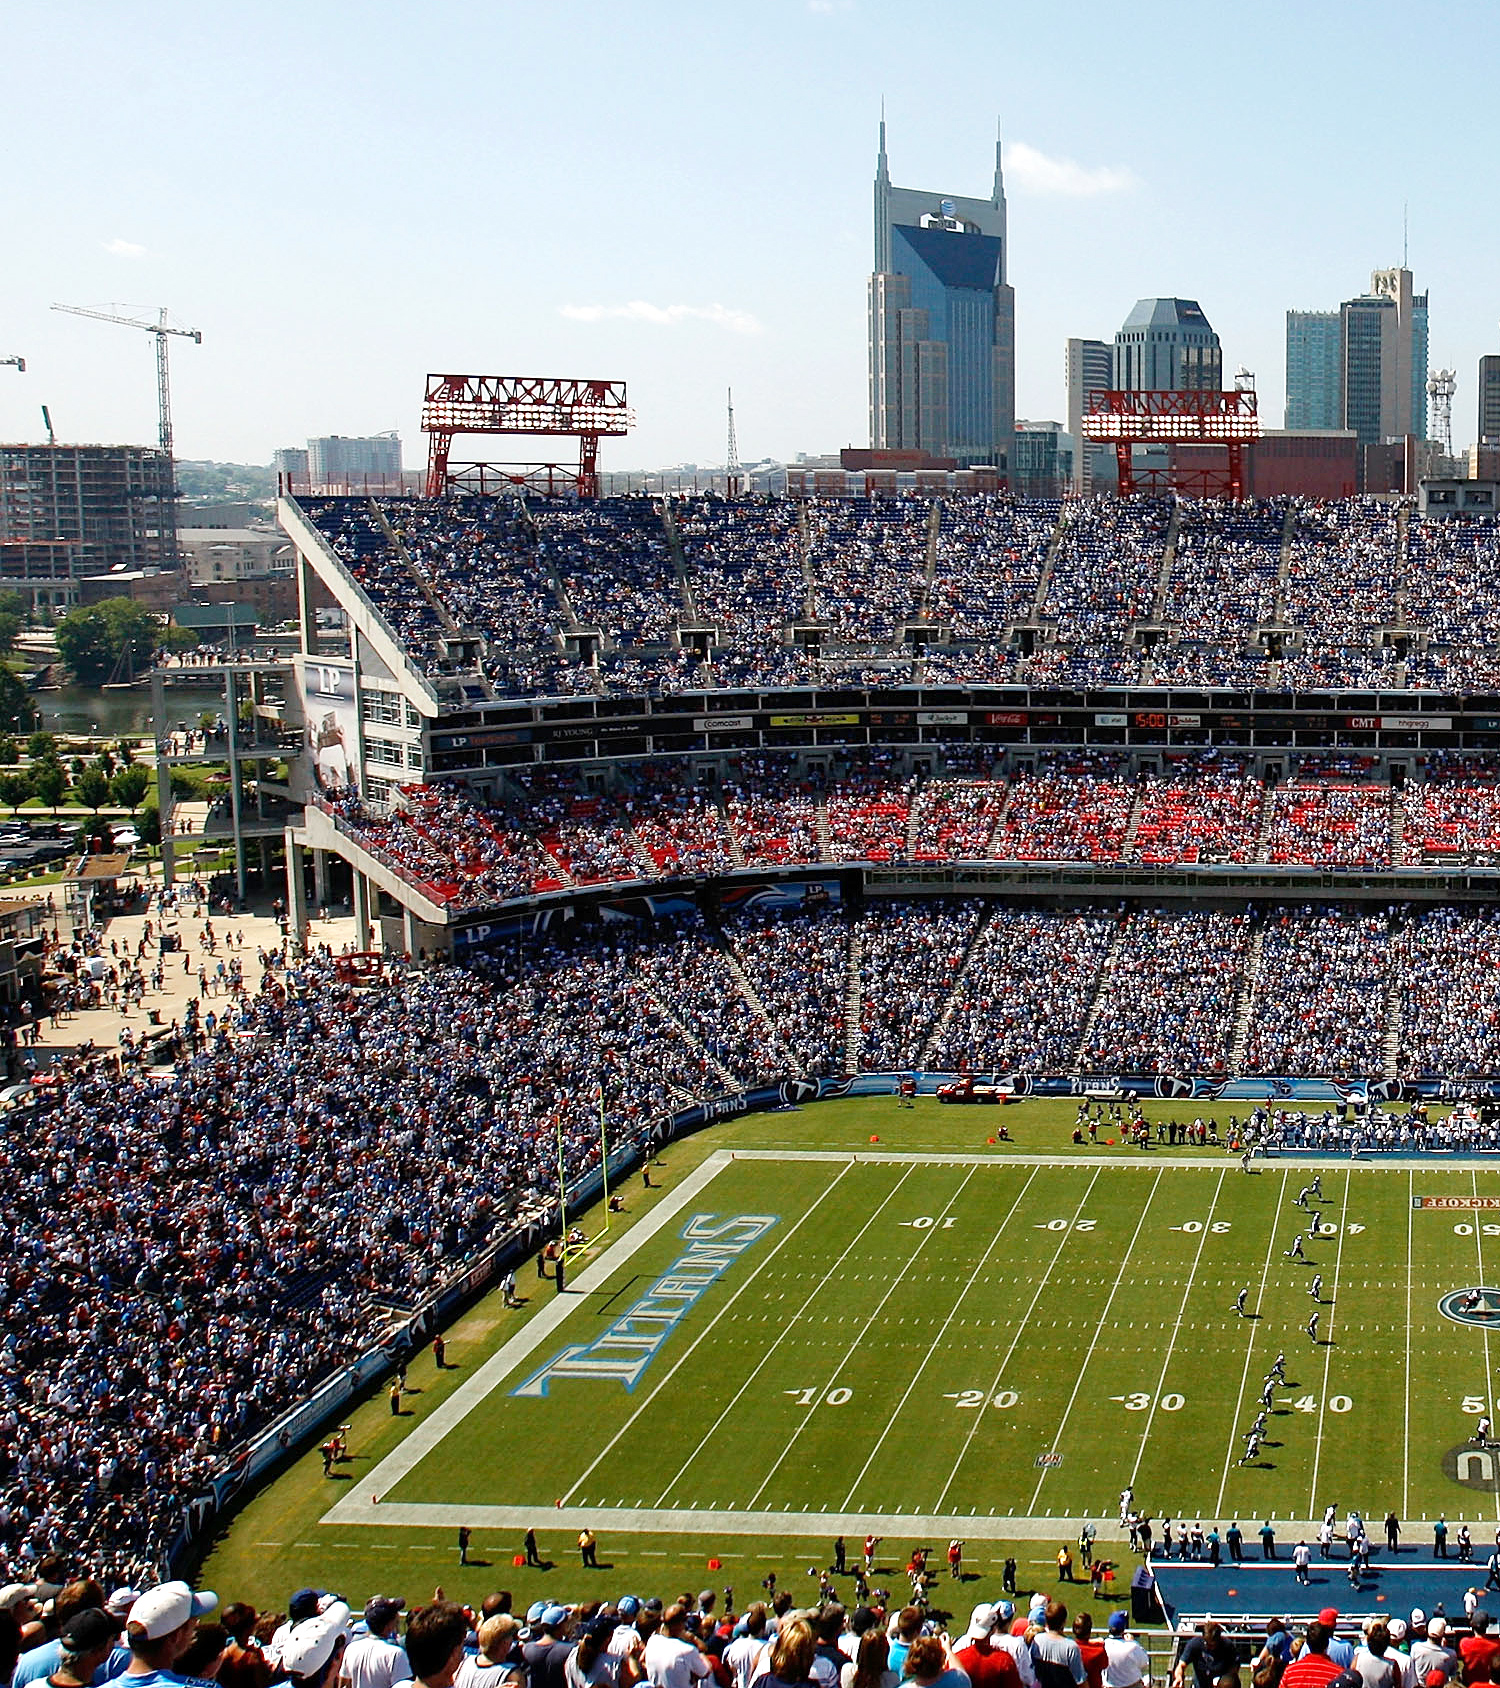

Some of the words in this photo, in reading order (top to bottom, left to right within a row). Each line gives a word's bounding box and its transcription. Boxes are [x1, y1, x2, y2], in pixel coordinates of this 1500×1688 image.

[318, 667, 340, 693] LP
[1352, 717, 1376, 729] CMT
[1398, 719, 1429, 728] hhgregg
[452, 736, 467, 747] LP
[808, 885, 822, 894] LP
[465, 925, 491, 944] LP
[1427, 1197, 1500, 1208] KICKOFF
[911, 1216, 957, 1230] 10
[1046, 1218, 1098, 1232] 20
[1182, 1220, 1232, 1234] 30
[1318, 1222, 1366, 1235] 40
[506, 1212, 781, 1397] TITANS
[793, 1387, 853, 1406] 10
[954, 1390, 1020, 1410] 20
[1121, 1392, 1186, 1411] 30
[1293, 1394, 1354, 1414] 40
